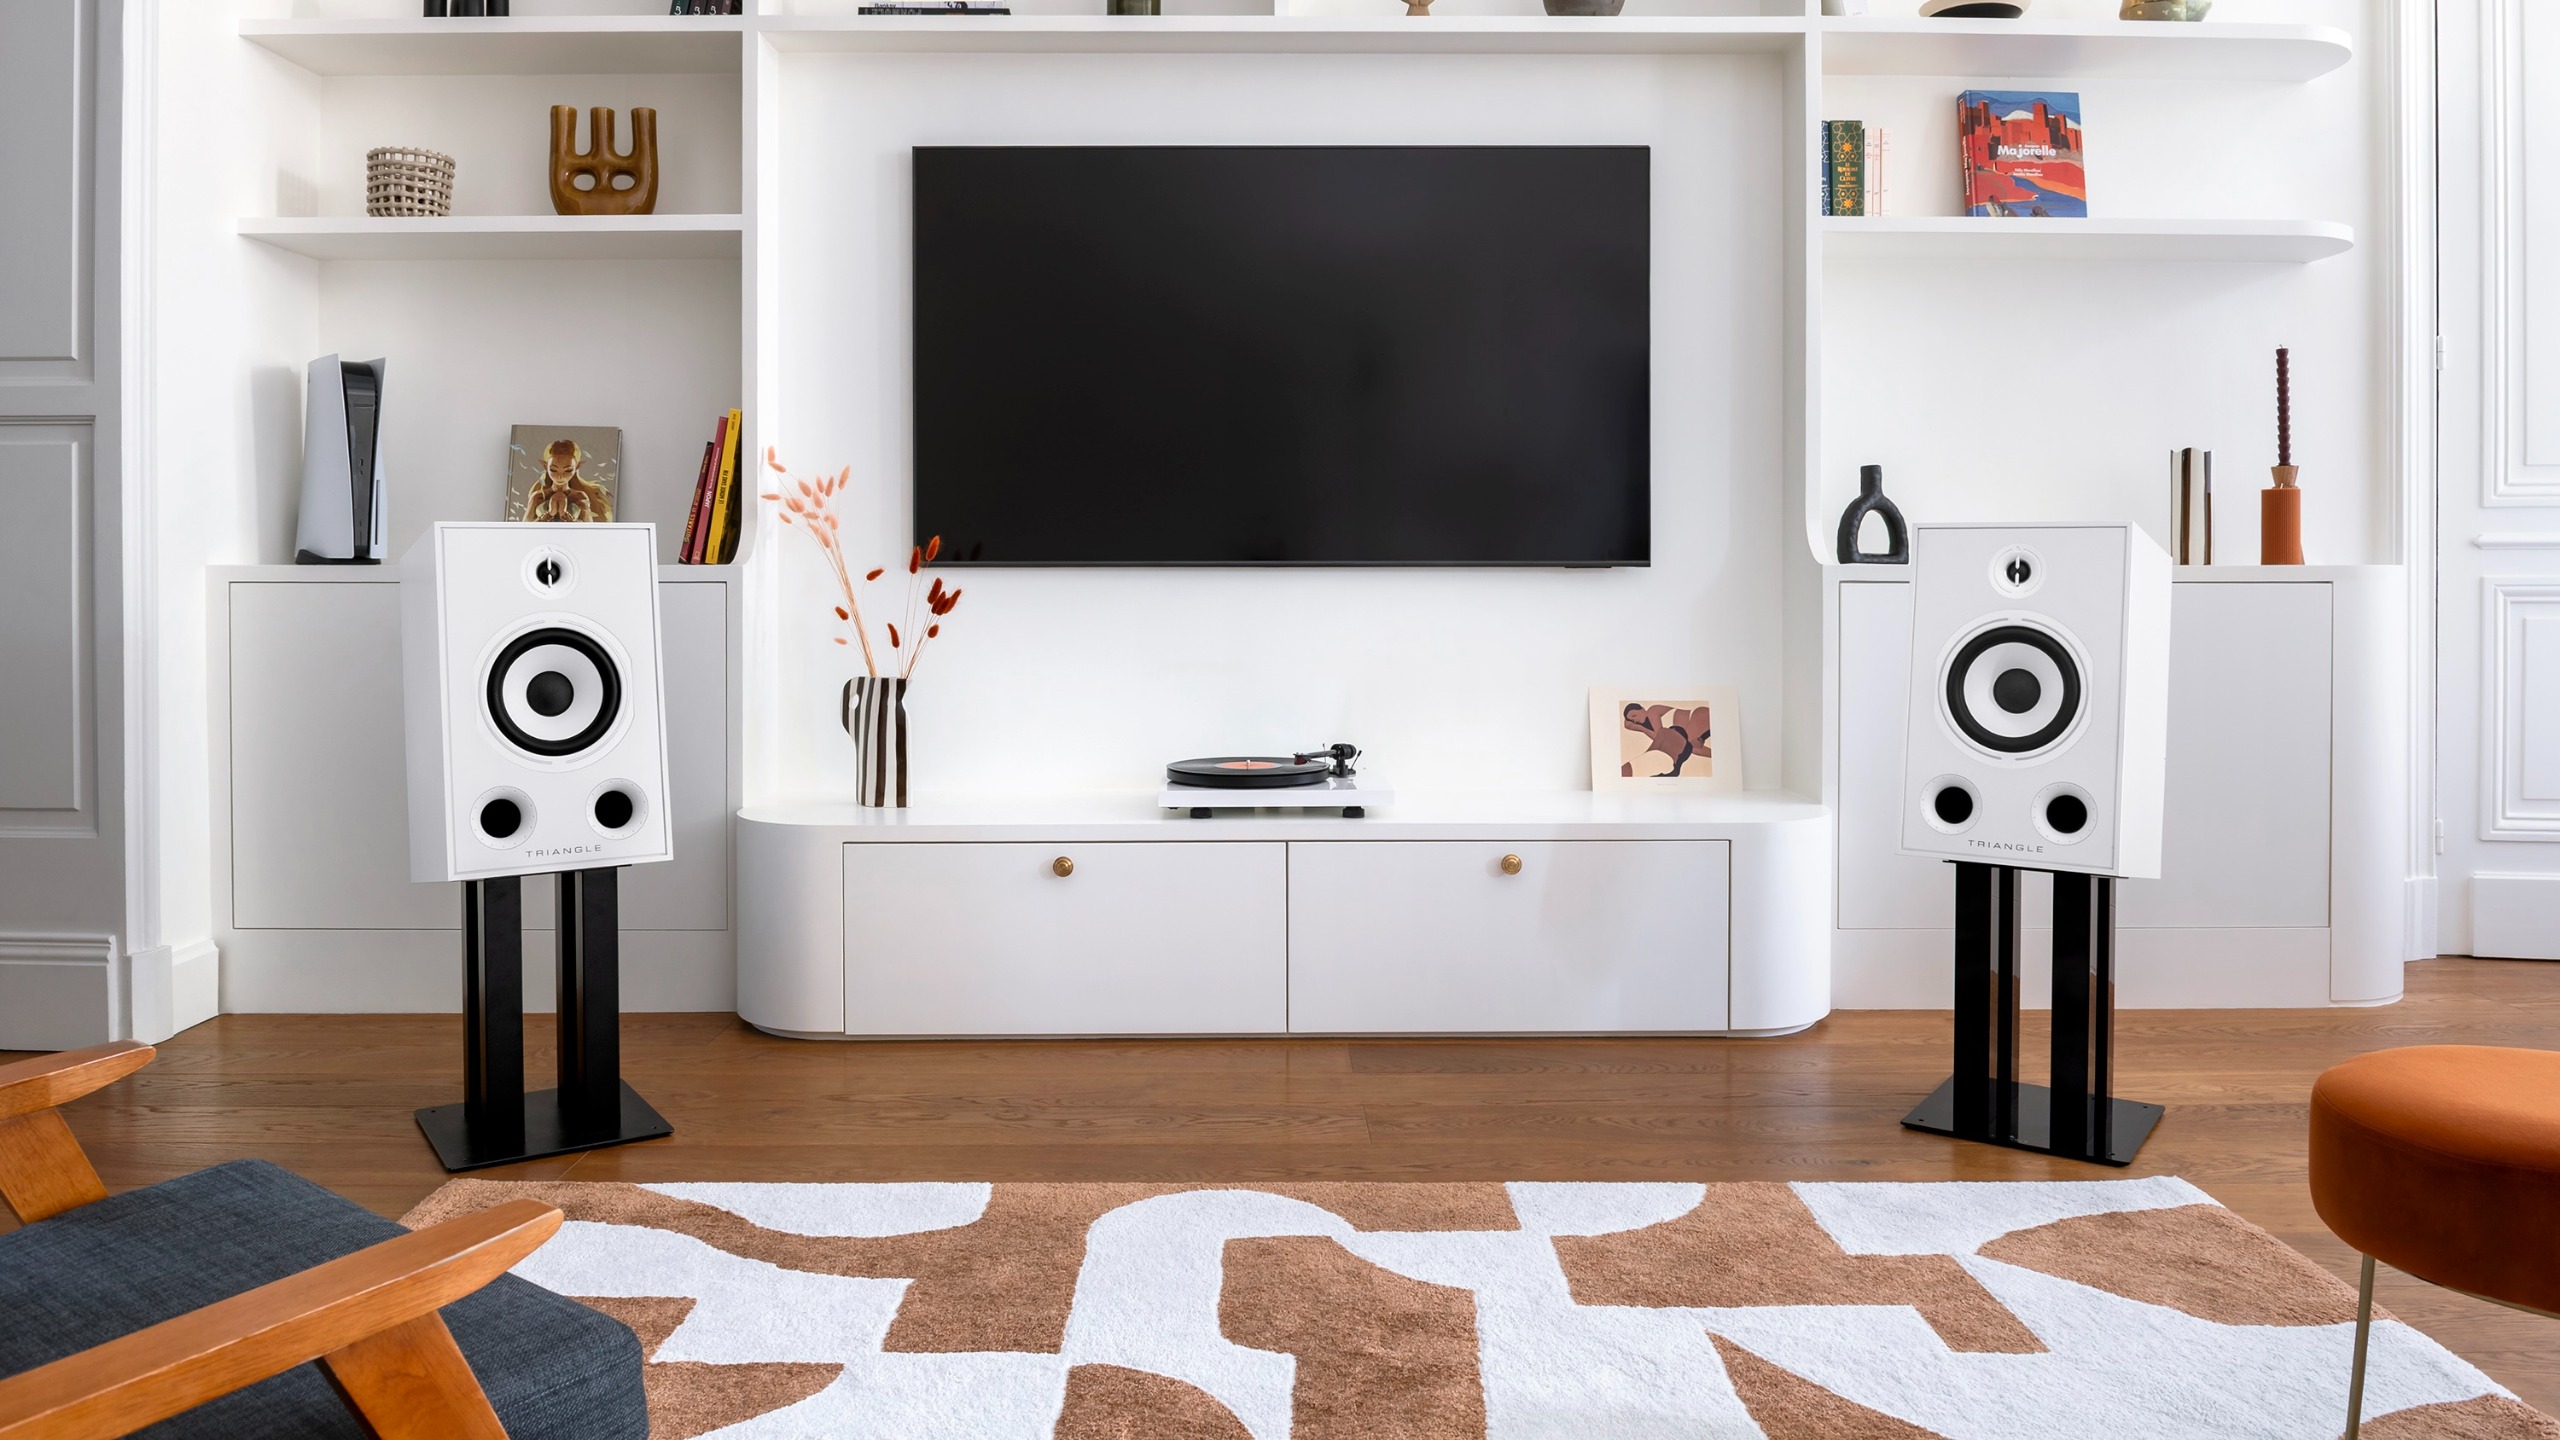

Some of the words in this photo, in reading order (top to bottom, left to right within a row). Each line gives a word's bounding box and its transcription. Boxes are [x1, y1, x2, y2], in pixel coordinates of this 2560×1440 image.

[1997, 144, 2057, 159] Majorelle
[704, 490, 712, 508] JAPON
[525, 844, 601, 858] TRIANGLE
[1968, 839, 2044, 853] TRIANGLE
